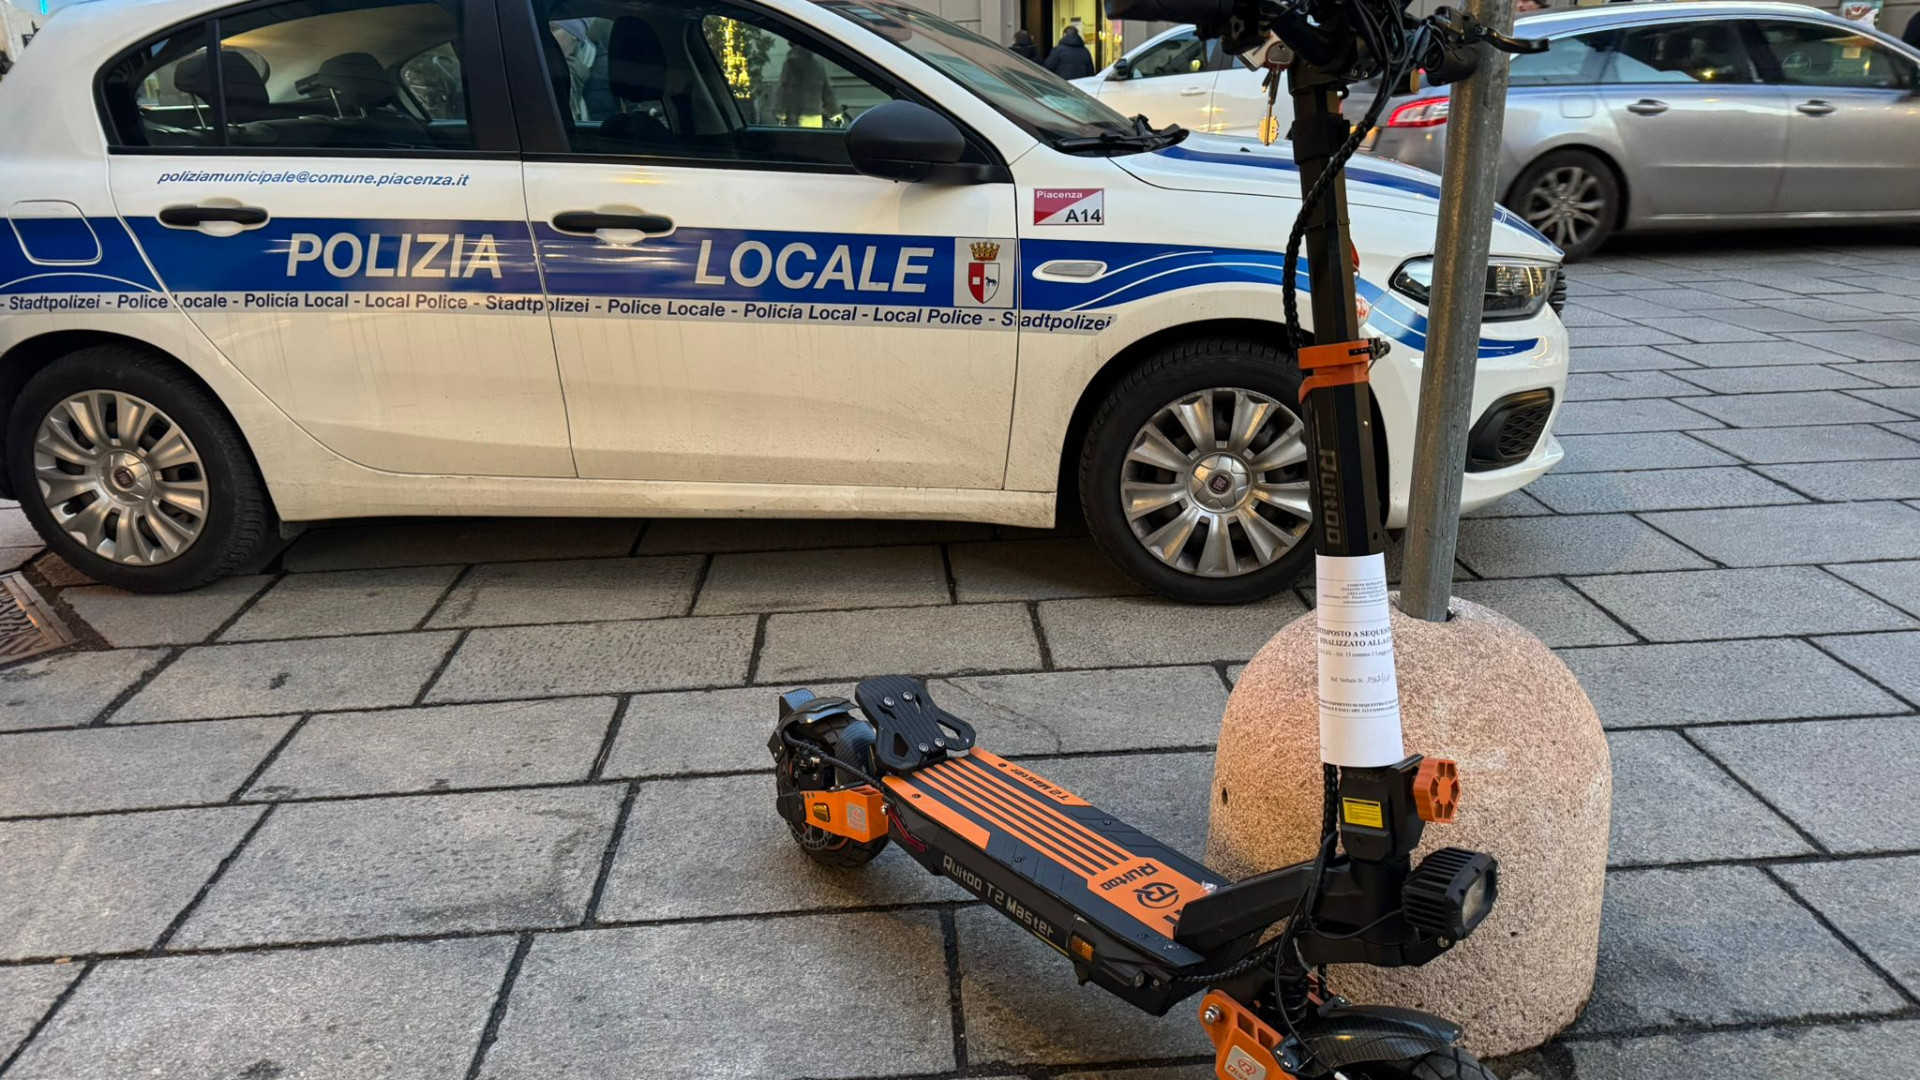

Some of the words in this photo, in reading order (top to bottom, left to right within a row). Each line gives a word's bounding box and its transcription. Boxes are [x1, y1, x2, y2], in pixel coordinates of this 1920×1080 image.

[156, 170, 471, 187] poliziamunicipale@comune.piacenza.it
[1036, 190, 1083, 199] Piacenza
[1064, 208, 1102, 223] A14
[286, 232, 503, 279] POLIZIA
[694, 239, 935, 293] LOCALE
[9, 294, 101, 312] Stadtpolizei
[117, 294, 168, 309] Police
[244, 293, 299, 308] Policía
[304, 293, 349, 308] Local
[365, 293, 410, 308] Local
[415, 294, 468, 309] Police
[607, 299, 662, 315] Police
[667, 301, 725, 317] Locale
[743, 303, 803, 319] Policía
[808, 305, 857, 321] Local
[873, 307, 923, 323] Local
[927, 309, 983, 325] Police
[1099, 862, 1159, 892] Ruitoo
[943, 854, 983, 892] Ruitoo
[986, 881, 1004, 906] T2
[1005, 896, 1055, 938] Master
